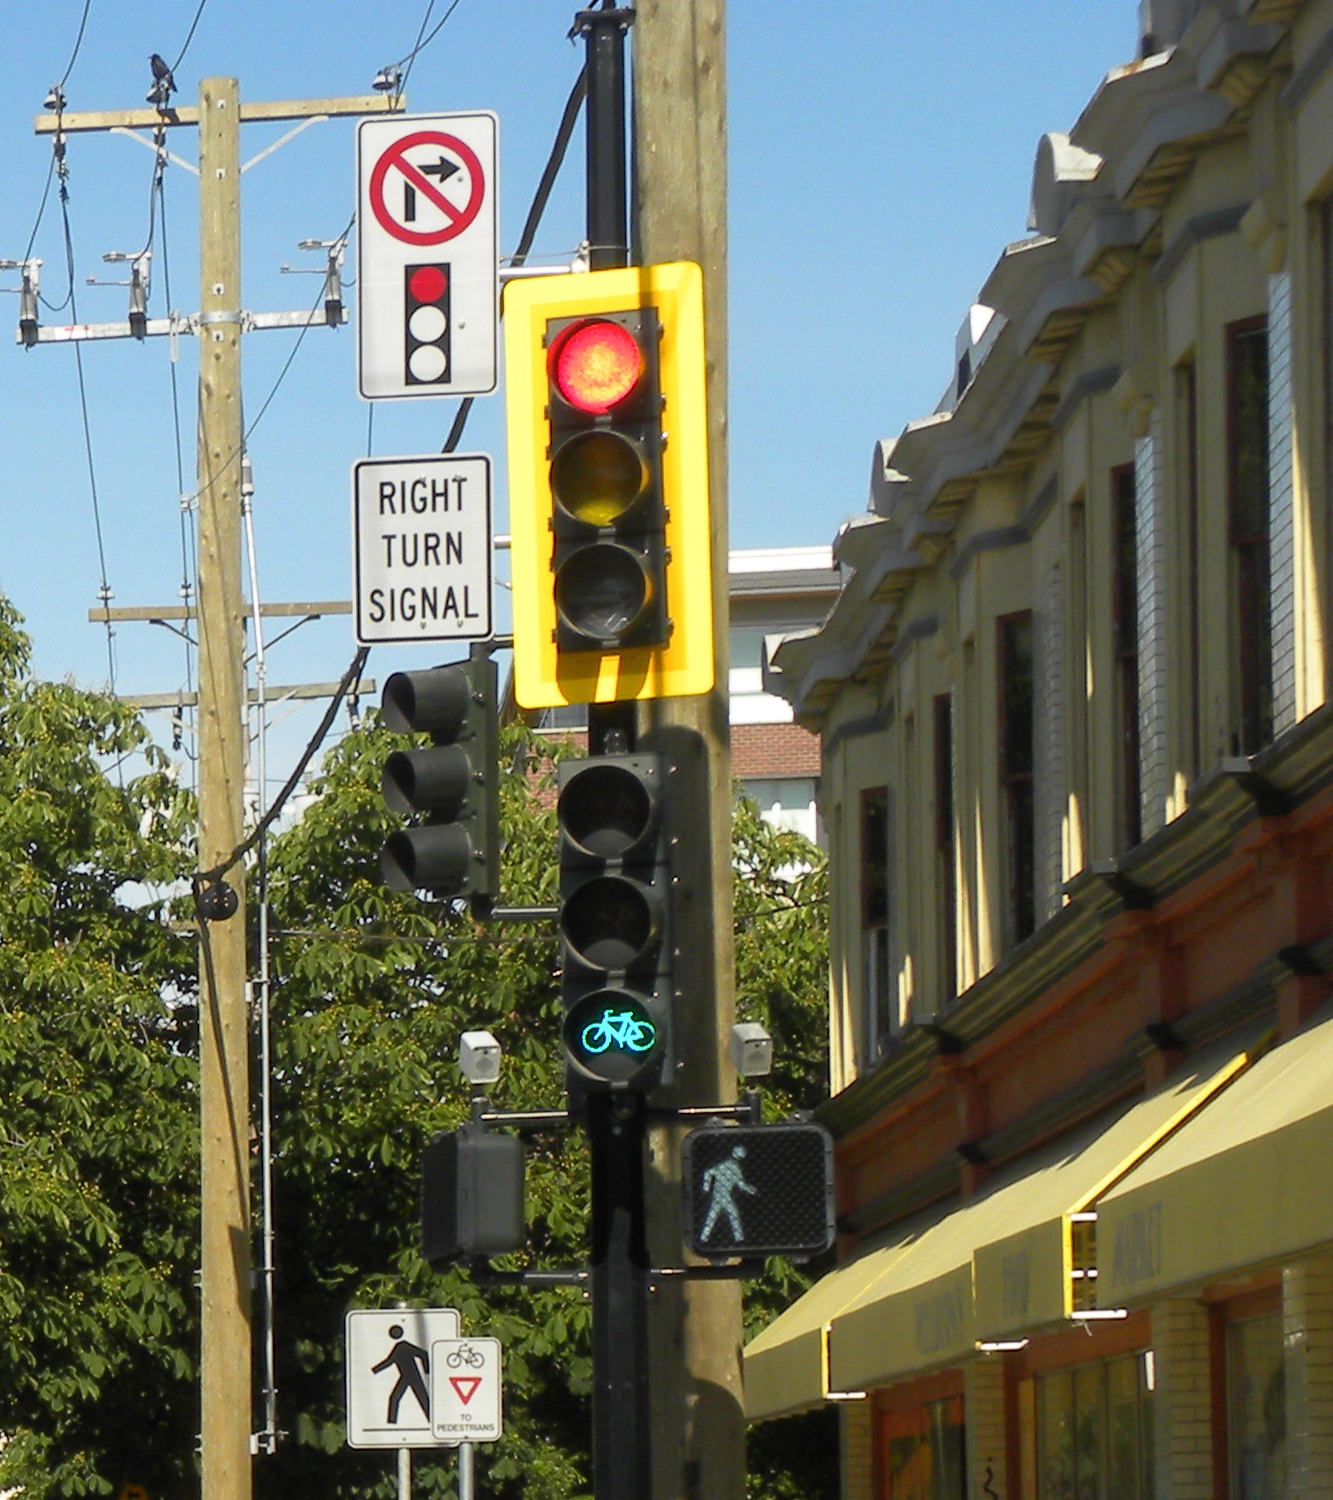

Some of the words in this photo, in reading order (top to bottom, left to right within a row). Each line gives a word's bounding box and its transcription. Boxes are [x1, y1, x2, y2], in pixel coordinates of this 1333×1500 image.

[378, 476, 468, 515] RIGHT
[381, 530, 463, 568] TURN
[368, 584, 479, 624] SIGNAL
[436, 1423, 495, 1433] PEDESTRIANS
[460, 1413, 473, 1422] TO
